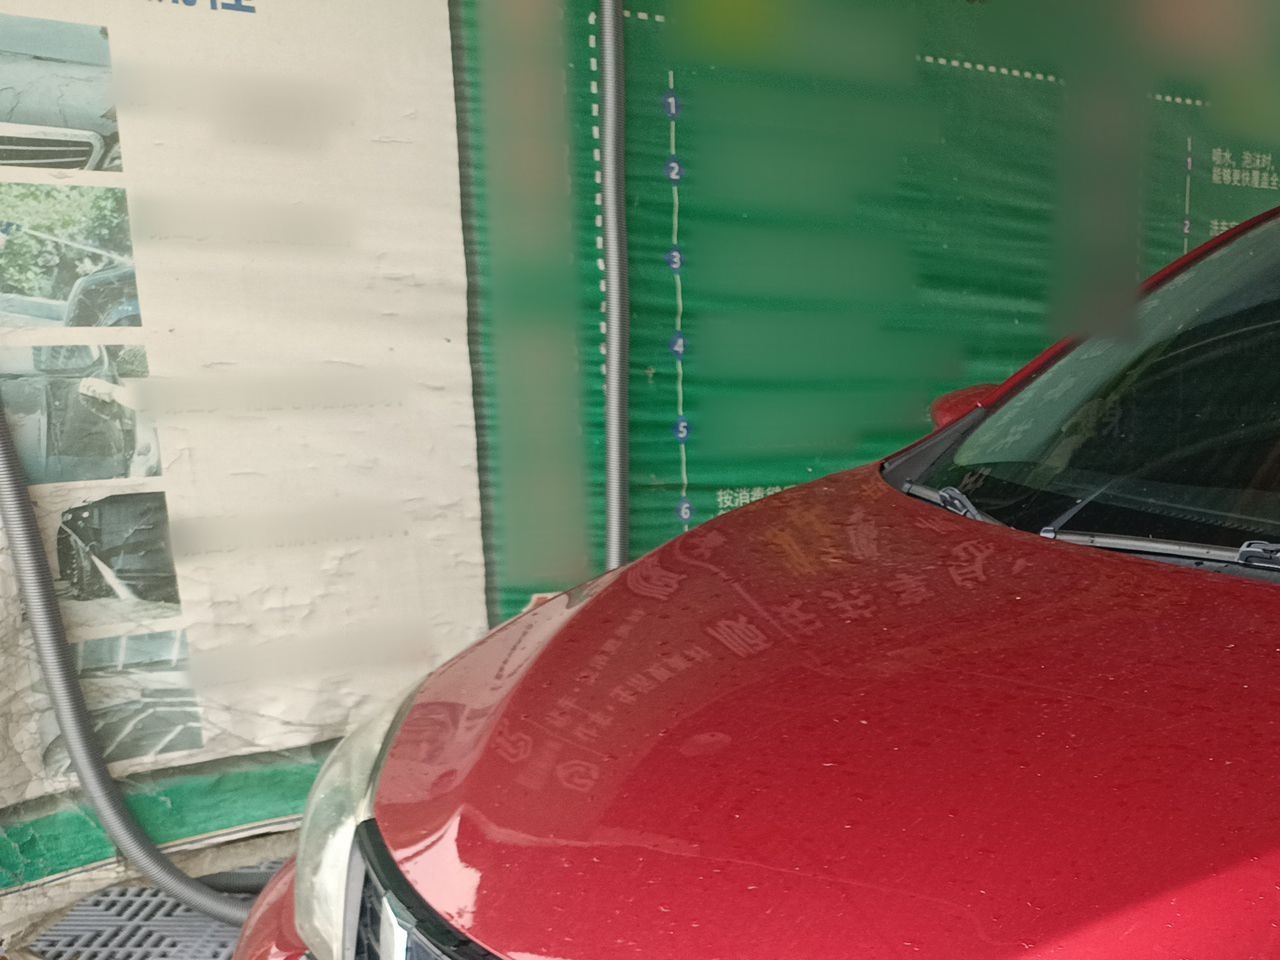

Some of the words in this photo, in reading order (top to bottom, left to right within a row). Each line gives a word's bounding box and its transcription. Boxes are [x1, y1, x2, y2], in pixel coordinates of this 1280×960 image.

[668, 96, 676, 114] 1
[669, 162, 680, 180] 2
[671, 251, 681, 269] 3
[673, 337, 684, 354] 4
[677, 421, 688, 439] 5
[679, 503, 690, 520] 6
